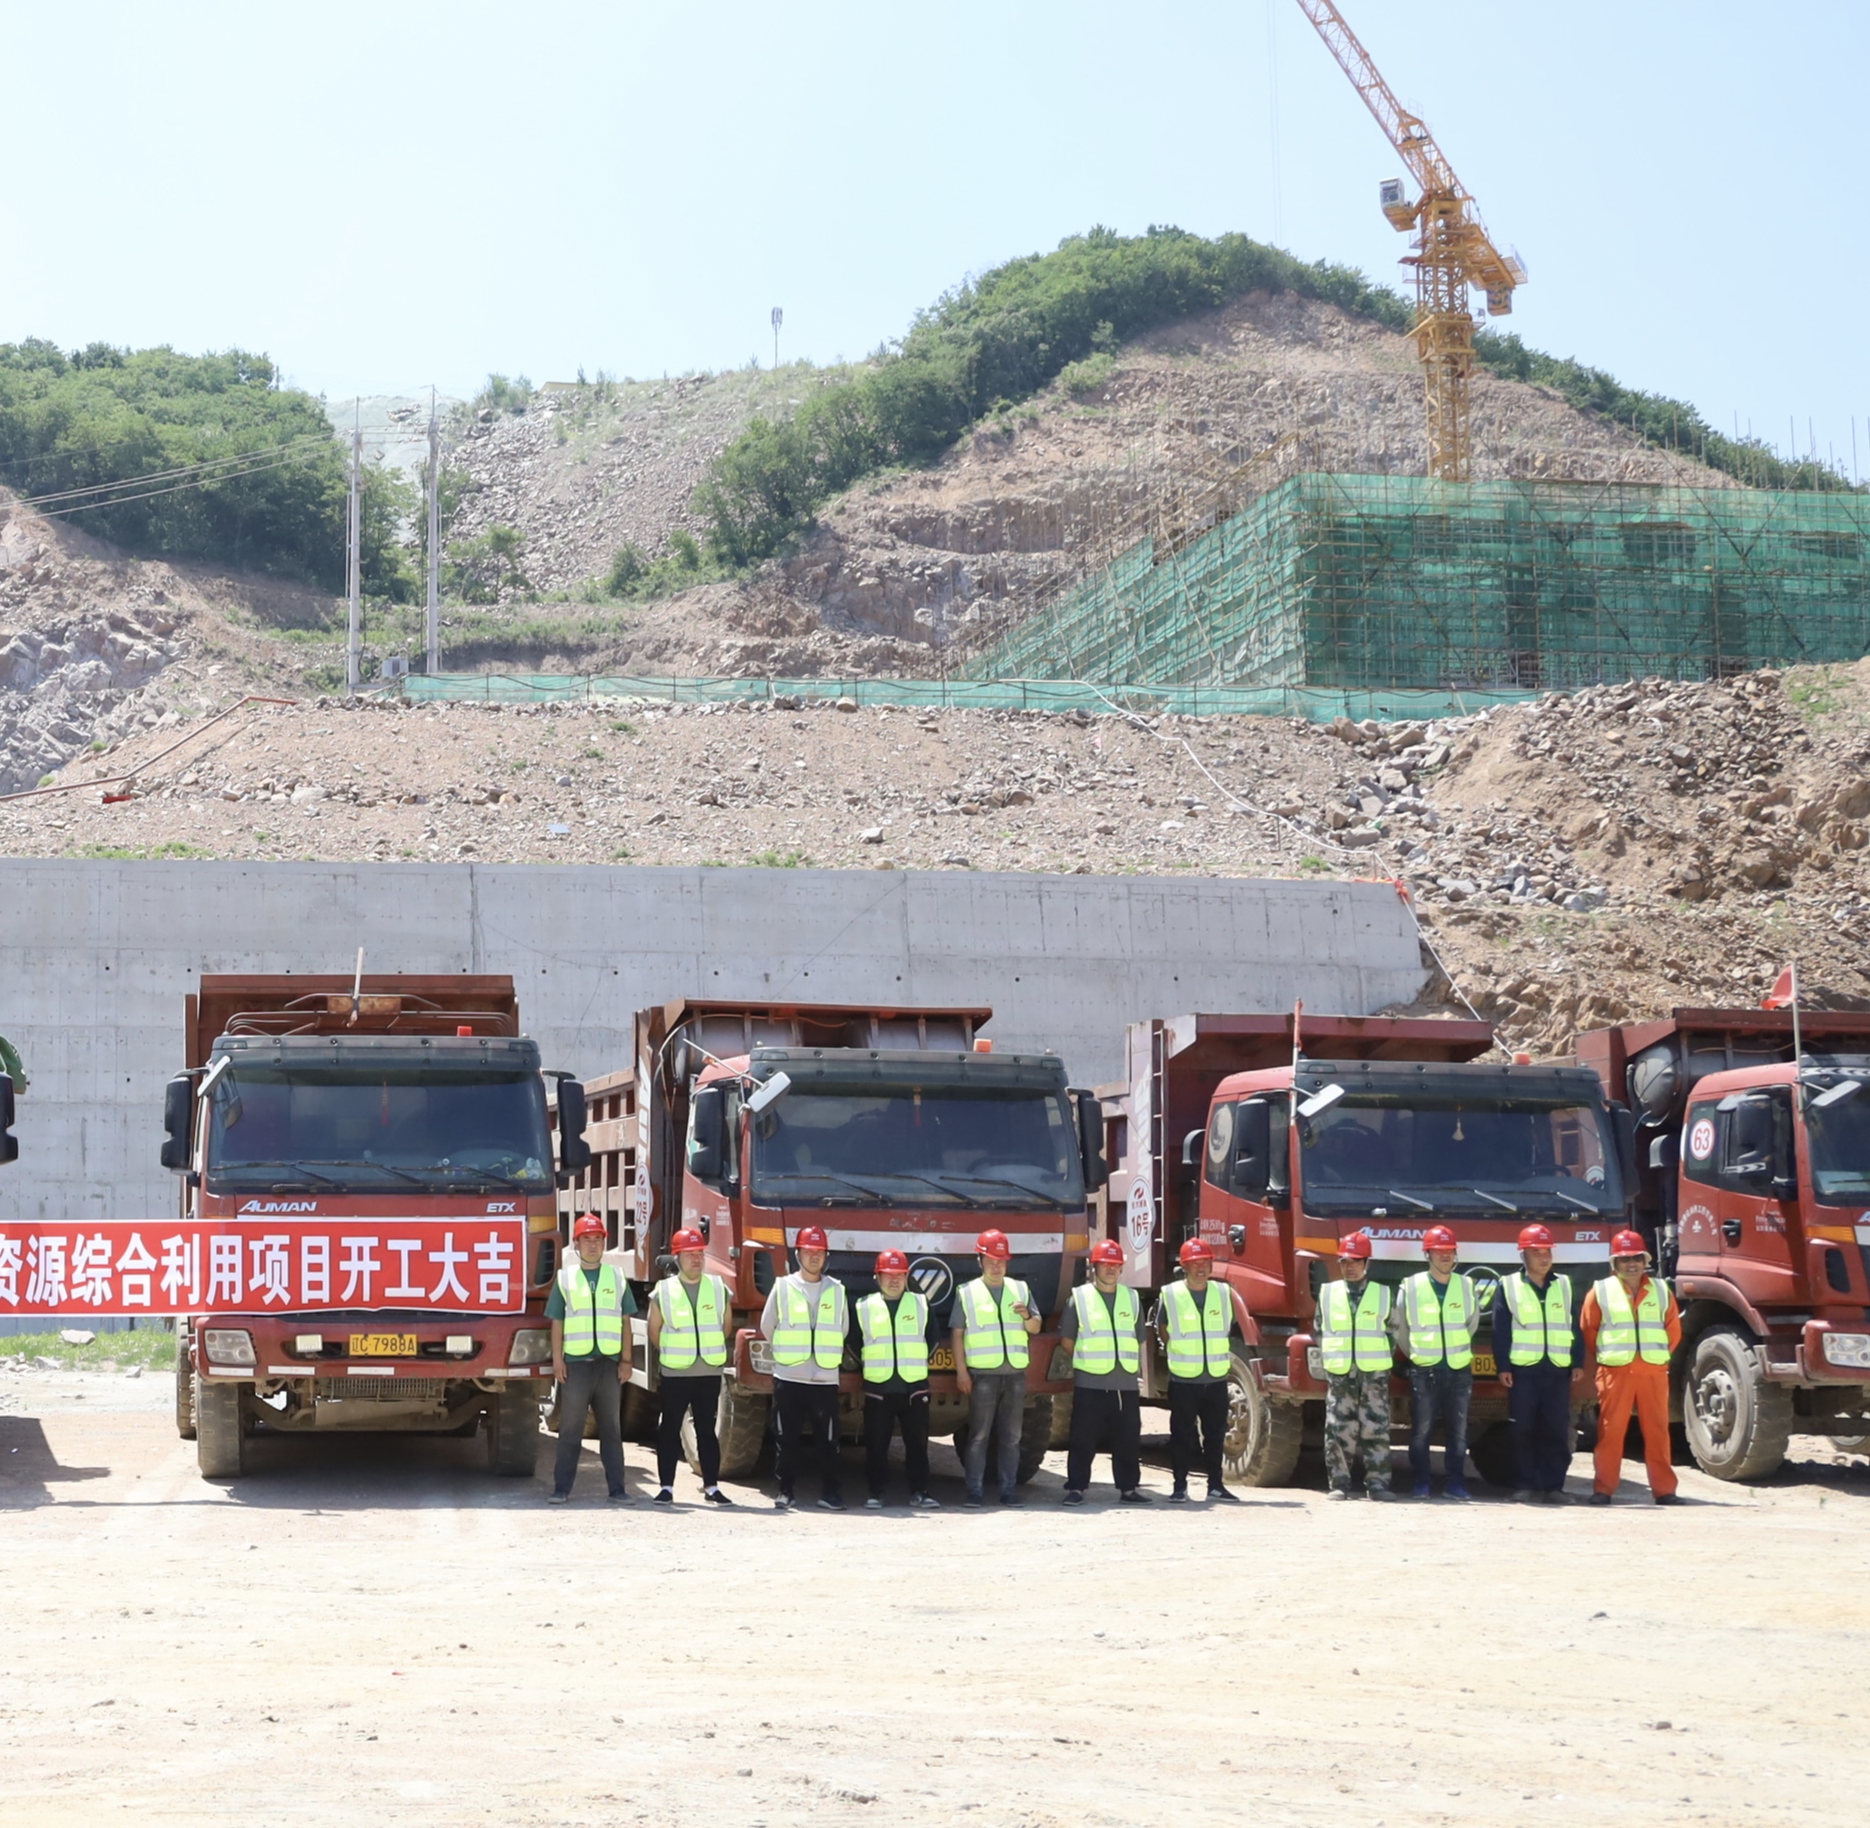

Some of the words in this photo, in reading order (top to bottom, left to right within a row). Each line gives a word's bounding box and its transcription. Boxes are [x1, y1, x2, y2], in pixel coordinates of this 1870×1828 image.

[1694, 1128, 1711, 1151] 63
[239, 1200, 317, 1213] AUMAN
[486, 1203, 516, 1213] ETX
[1131, 1212, 1149, 1237] 16号
[1575, 1231, 1601, 1241] ETX
